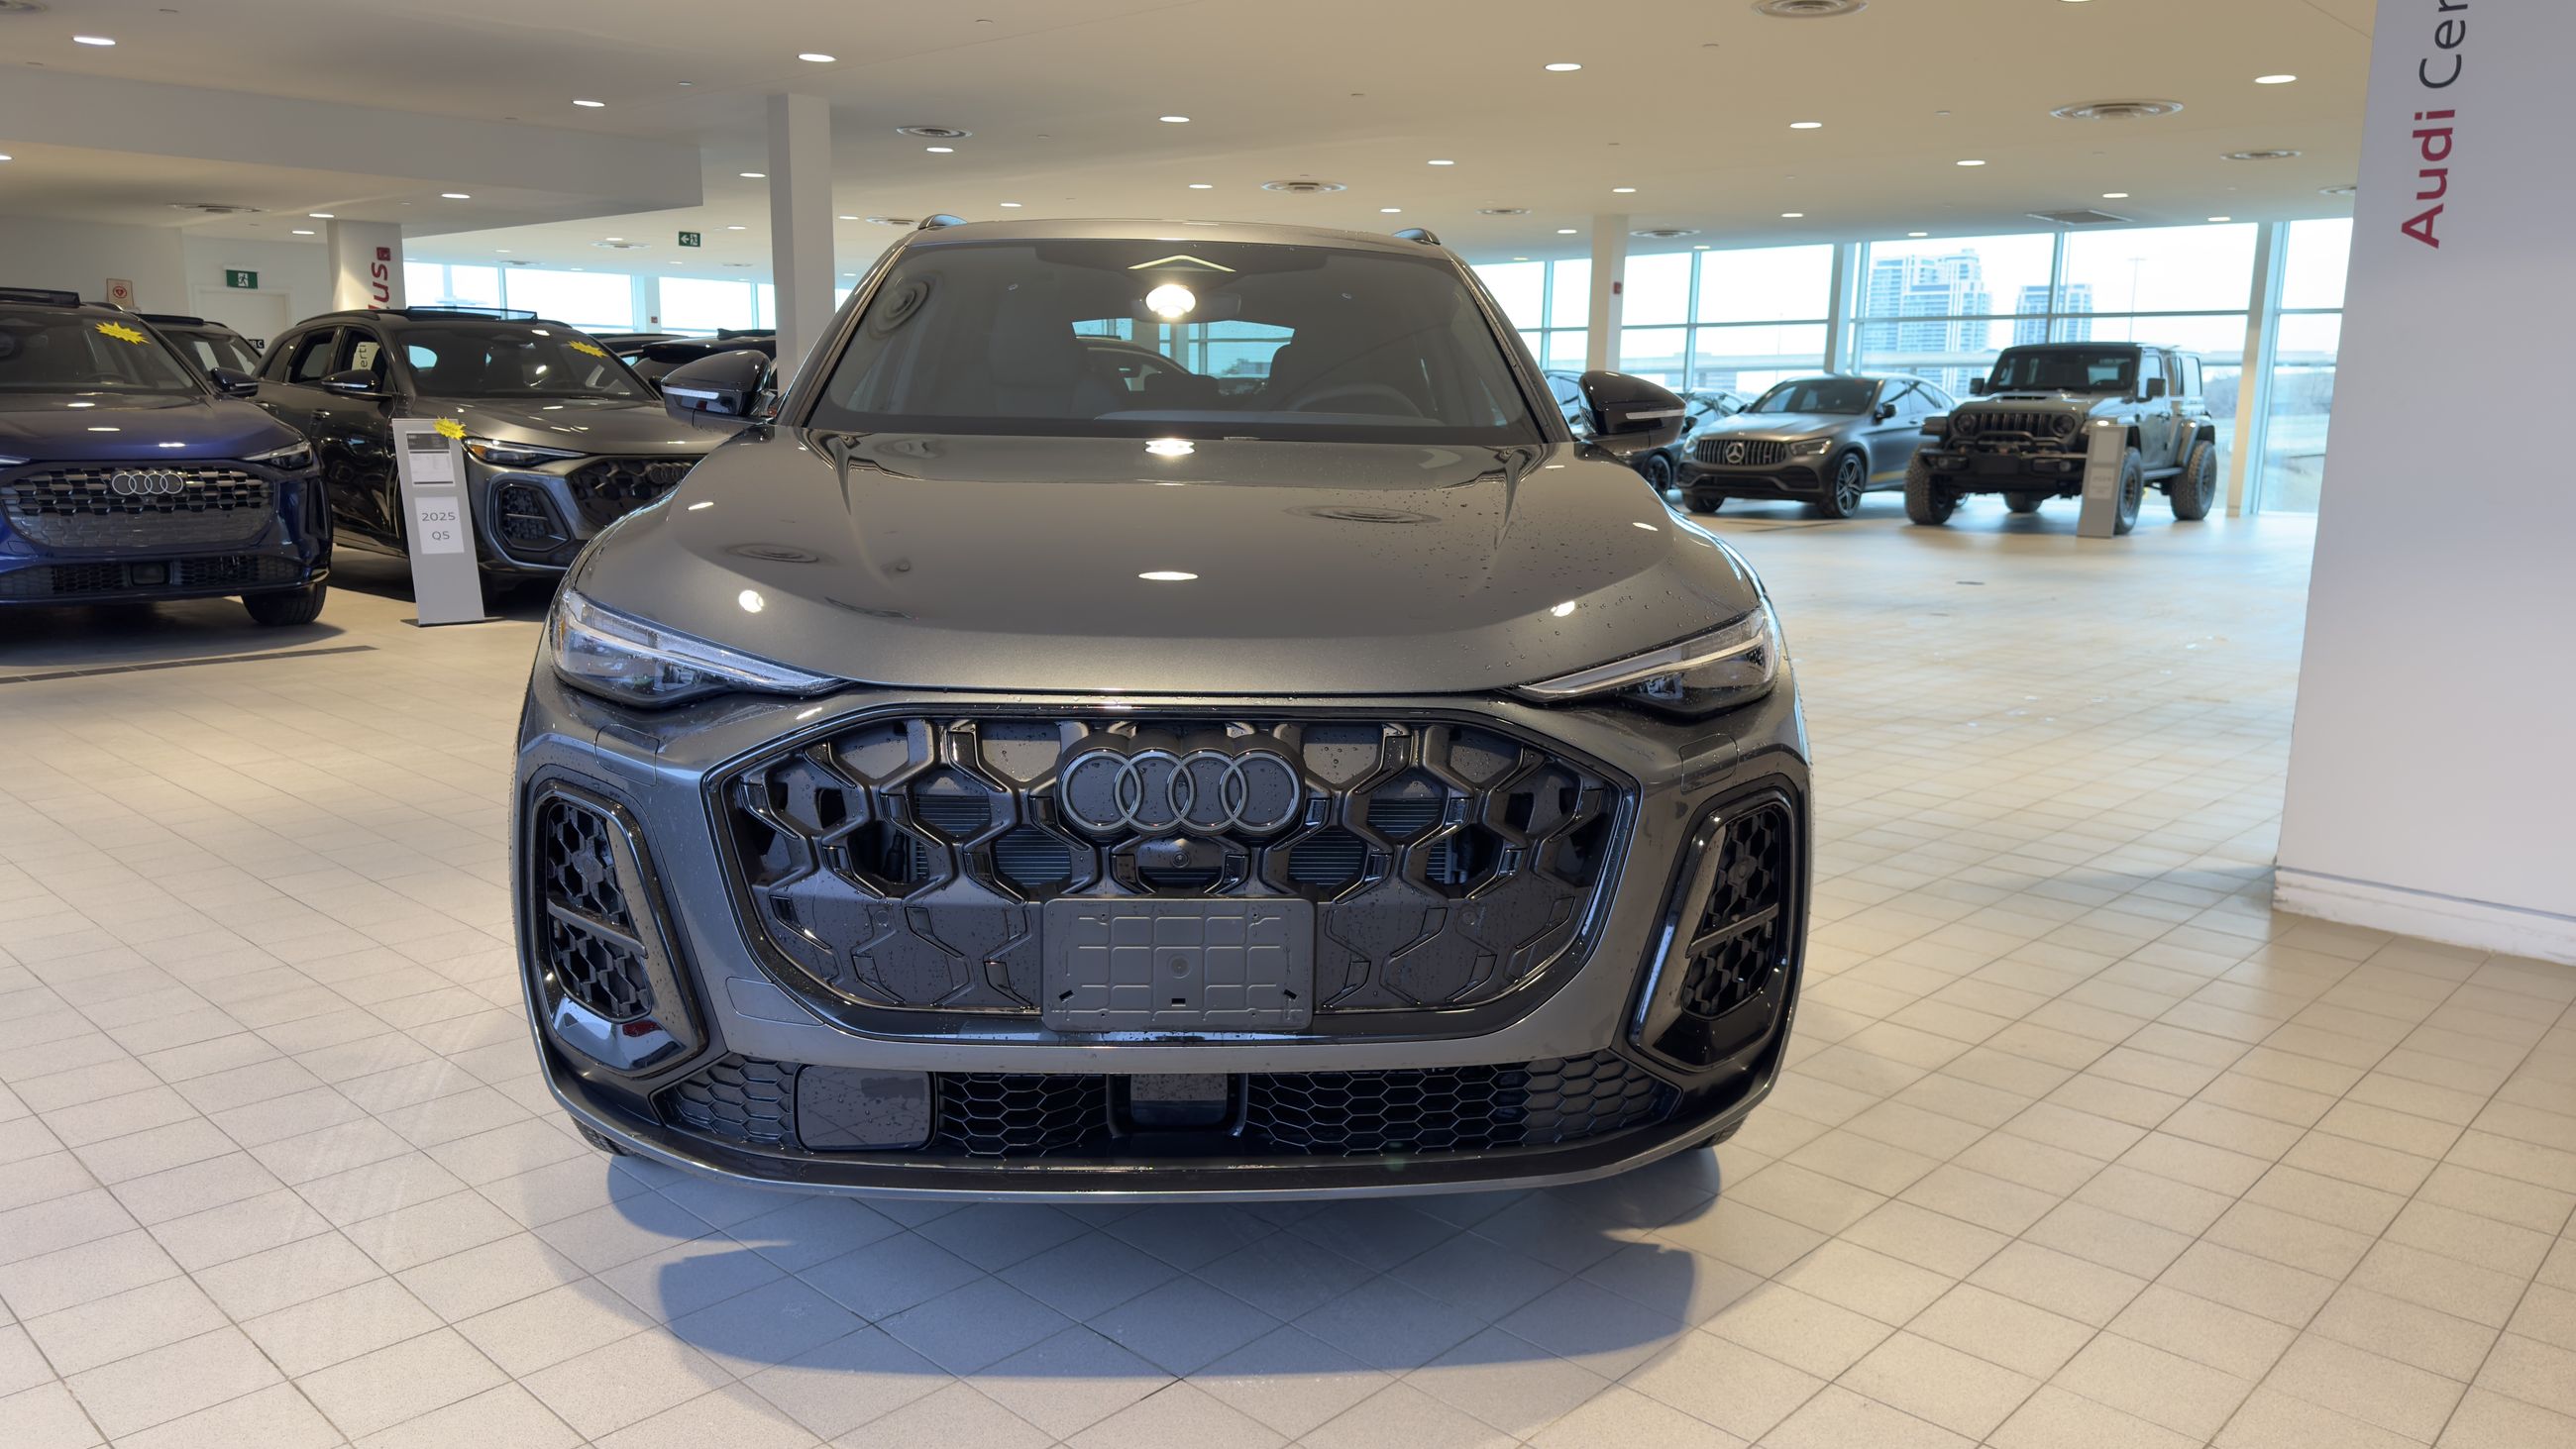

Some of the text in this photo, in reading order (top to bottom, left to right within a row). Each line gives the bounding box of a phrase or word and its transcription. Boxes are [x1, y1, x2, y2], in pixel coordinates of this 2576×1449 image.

[2401, 109, 2456, 249] Audi
[421, 512, 456, 521] 2025
[431, 531, 451, 541] Q5
